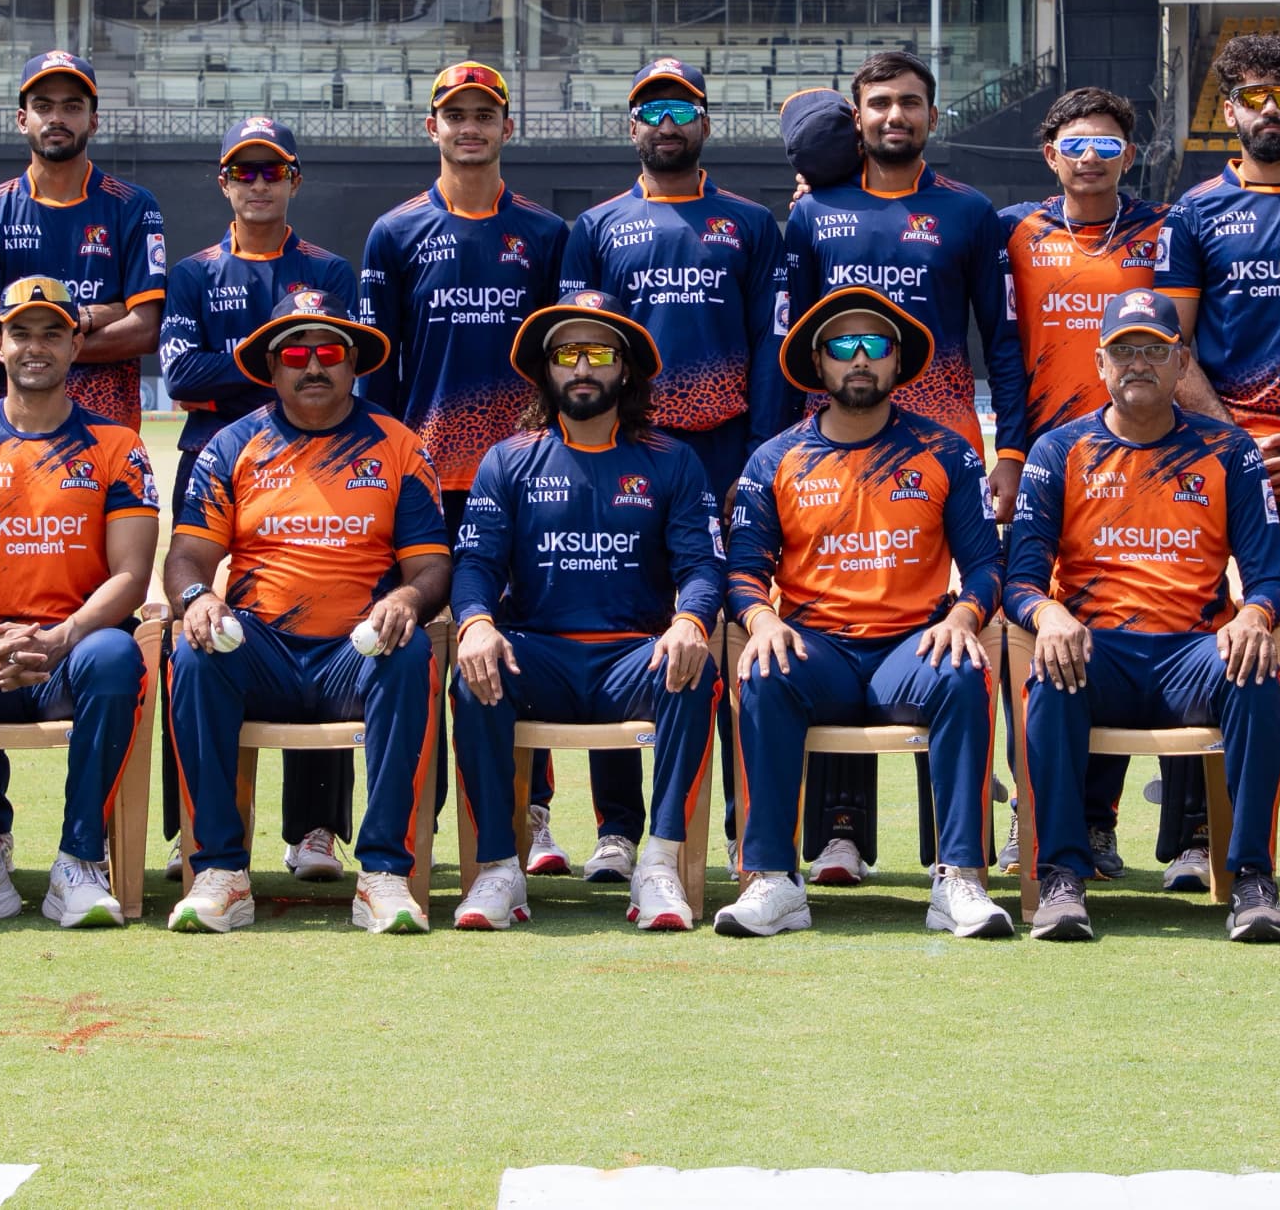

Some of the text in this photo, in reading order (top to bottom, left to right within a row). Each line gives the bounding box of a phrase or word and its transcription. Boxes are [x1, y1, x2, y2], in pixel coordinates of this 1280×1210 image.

[815, 213, 859, 226] VISWA
[4, 224, 42, 236] VISWA
[818, 226, 856, 241] KIRTI
[1215, 223, 1255, 236] KIRTI
[4, 238, 40, 250] KIRTI
[613, 230, 653, 248] KIRTI
[1029, 242, 1074, 253] VISWA
[1032, 255, 1071, 267] KIRTI
[628, 267, 726, 291] JKsuper
[828, 264, 927, 290] JKsuper
[208, 285, 248, 297] VISWA
[649, 291, 705, 304] cement
[210, 299, 247, 312] KIRTI
[428, 287, 525, 314] JKsuper
[451, 311, 505, 324] cement
[61, 478, 98, 490] CHEETAHS
[347, 479, 386, 489] CHEETAHS
[527, 476, 571, 489] VISWA
[793, 477, 841, 491] VISWA
[1083, 471, 1127, 485] VISWA
[528, 490, 568, 503] KIRTI
[891, 490, 928, 501] CHEETAHS
[1085, 485, 1124, 500] KIRTI
[615, 495, 652, 508] CHEETAHS
[798, 491, 840, 508] KIRTI
[257, 515, 375, 541] JKsuper
[537, 532, 639, 558] JKsuper
[818, 528, 919, 557] JKsuper
[1094, 526, 1200, 553] JKsuper
[6, 540, 65, 554] cement
[840, 554, 896, 572] cement
[1119, 551, 1180, 563] cement
[560, 557, 618, 571] cement
